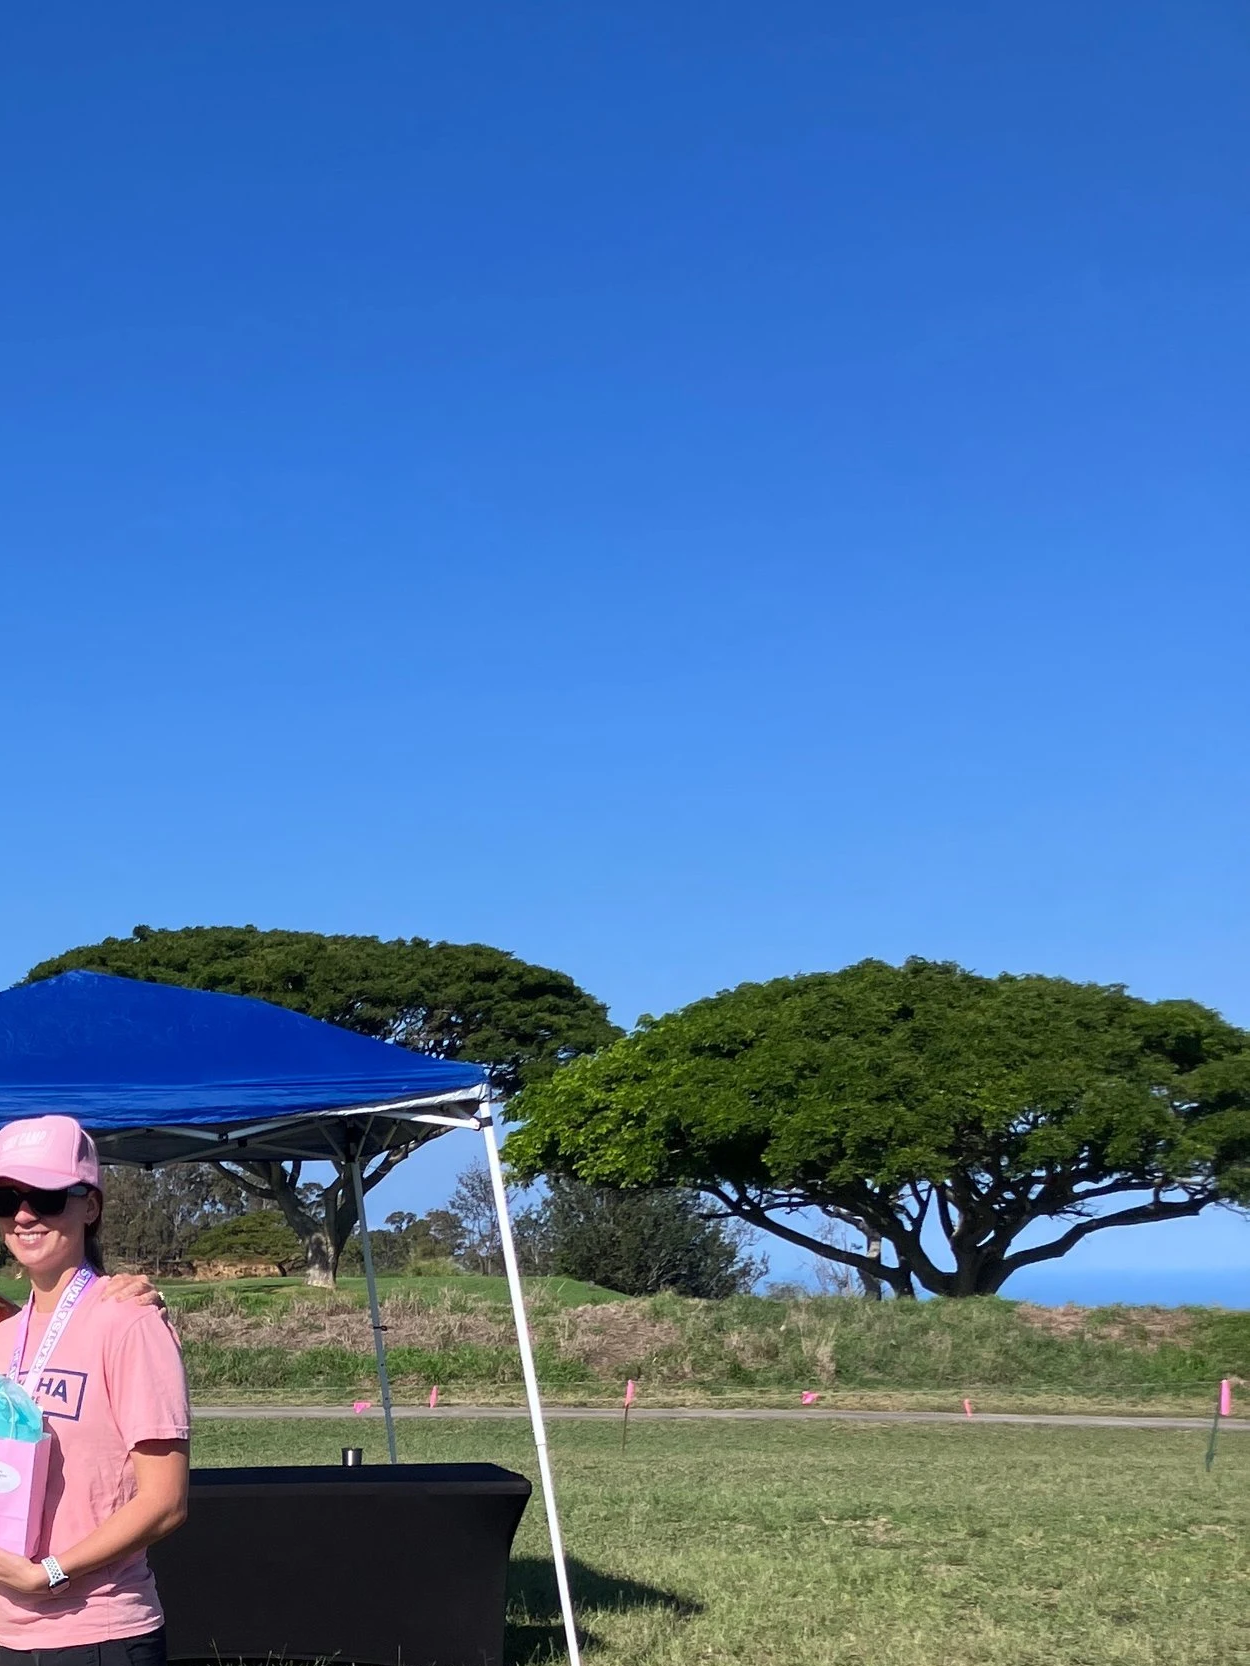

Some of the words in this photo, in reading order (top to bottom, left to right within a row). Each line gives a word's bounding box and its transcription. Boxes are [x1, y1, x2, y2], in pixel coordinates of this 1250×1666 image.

[61, 1269, 91, 1309] TRAILS
[56, 1310, 68, 1321] &
[33, 1321, 62, 1373] HEARTS
